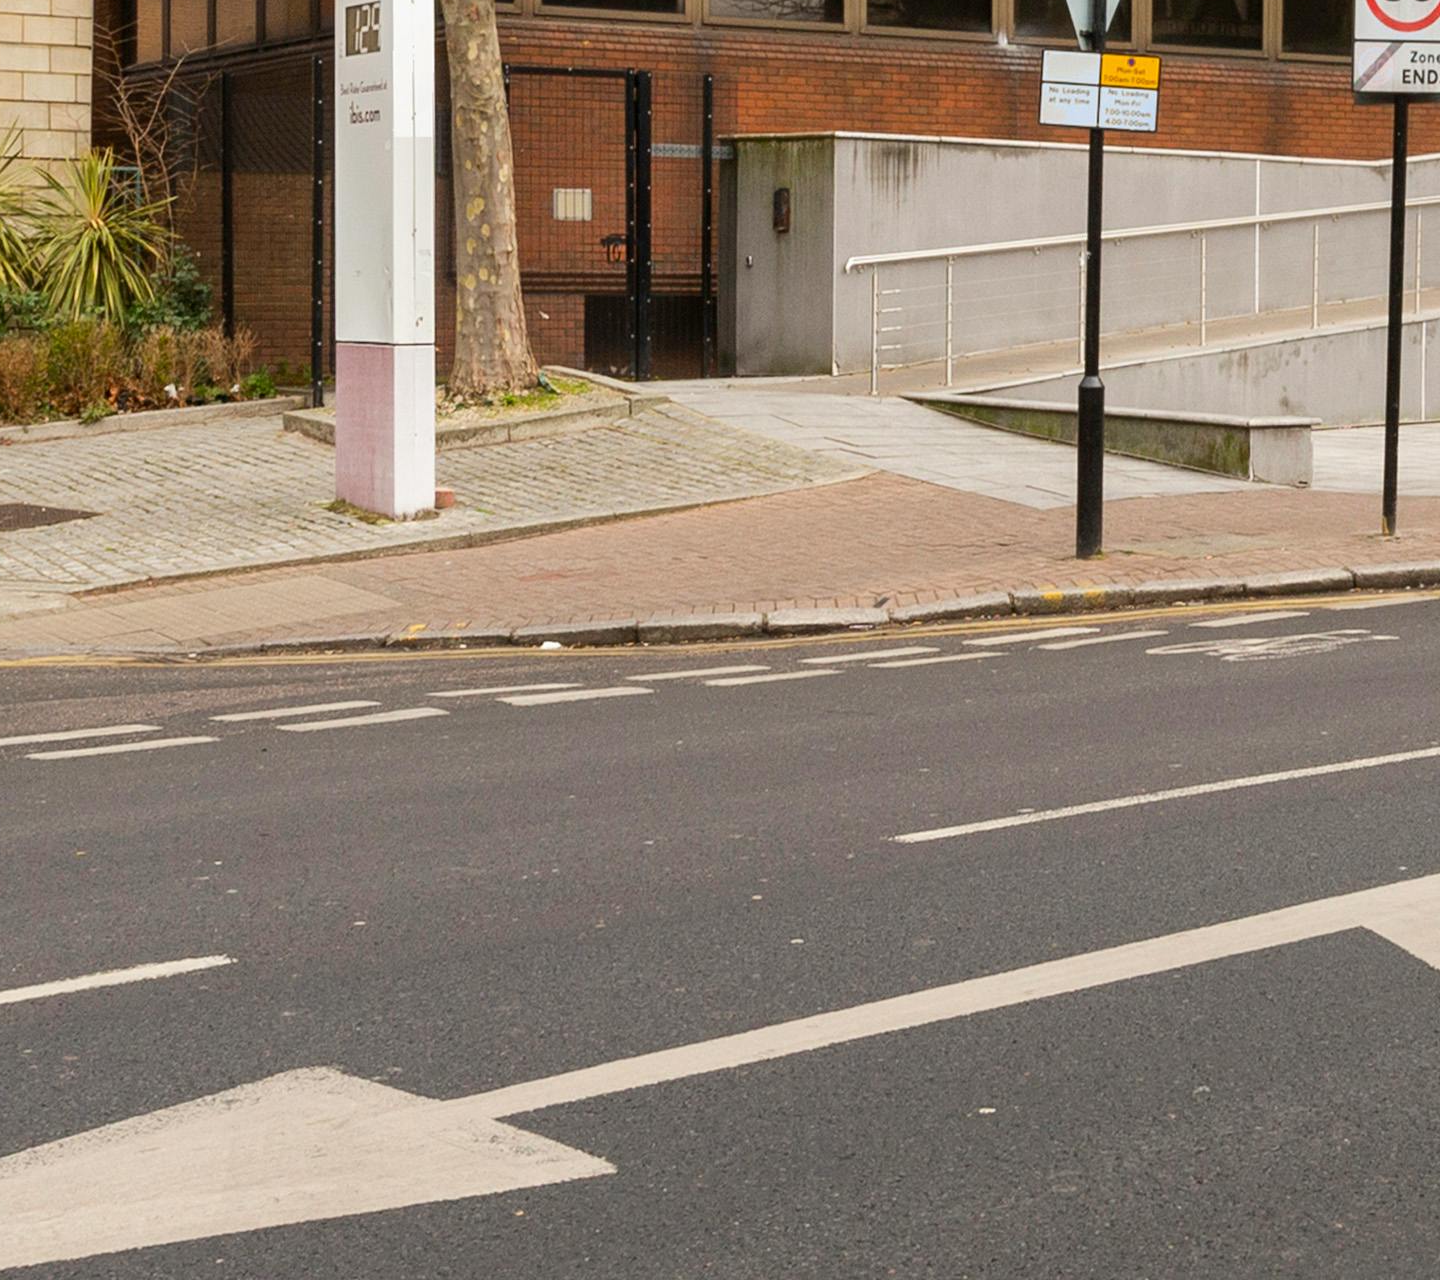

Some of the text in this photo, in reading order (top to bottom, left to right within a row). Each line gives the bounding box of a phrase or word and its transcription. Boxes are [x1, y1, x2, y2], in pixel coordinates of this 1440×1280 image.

[1062, 87, 1090, 96] Loading
[1121, 90, 1149, 99] Loading
[1074, 97, 1090, 105] time
[349, 99, 381, 124] ibis.com
